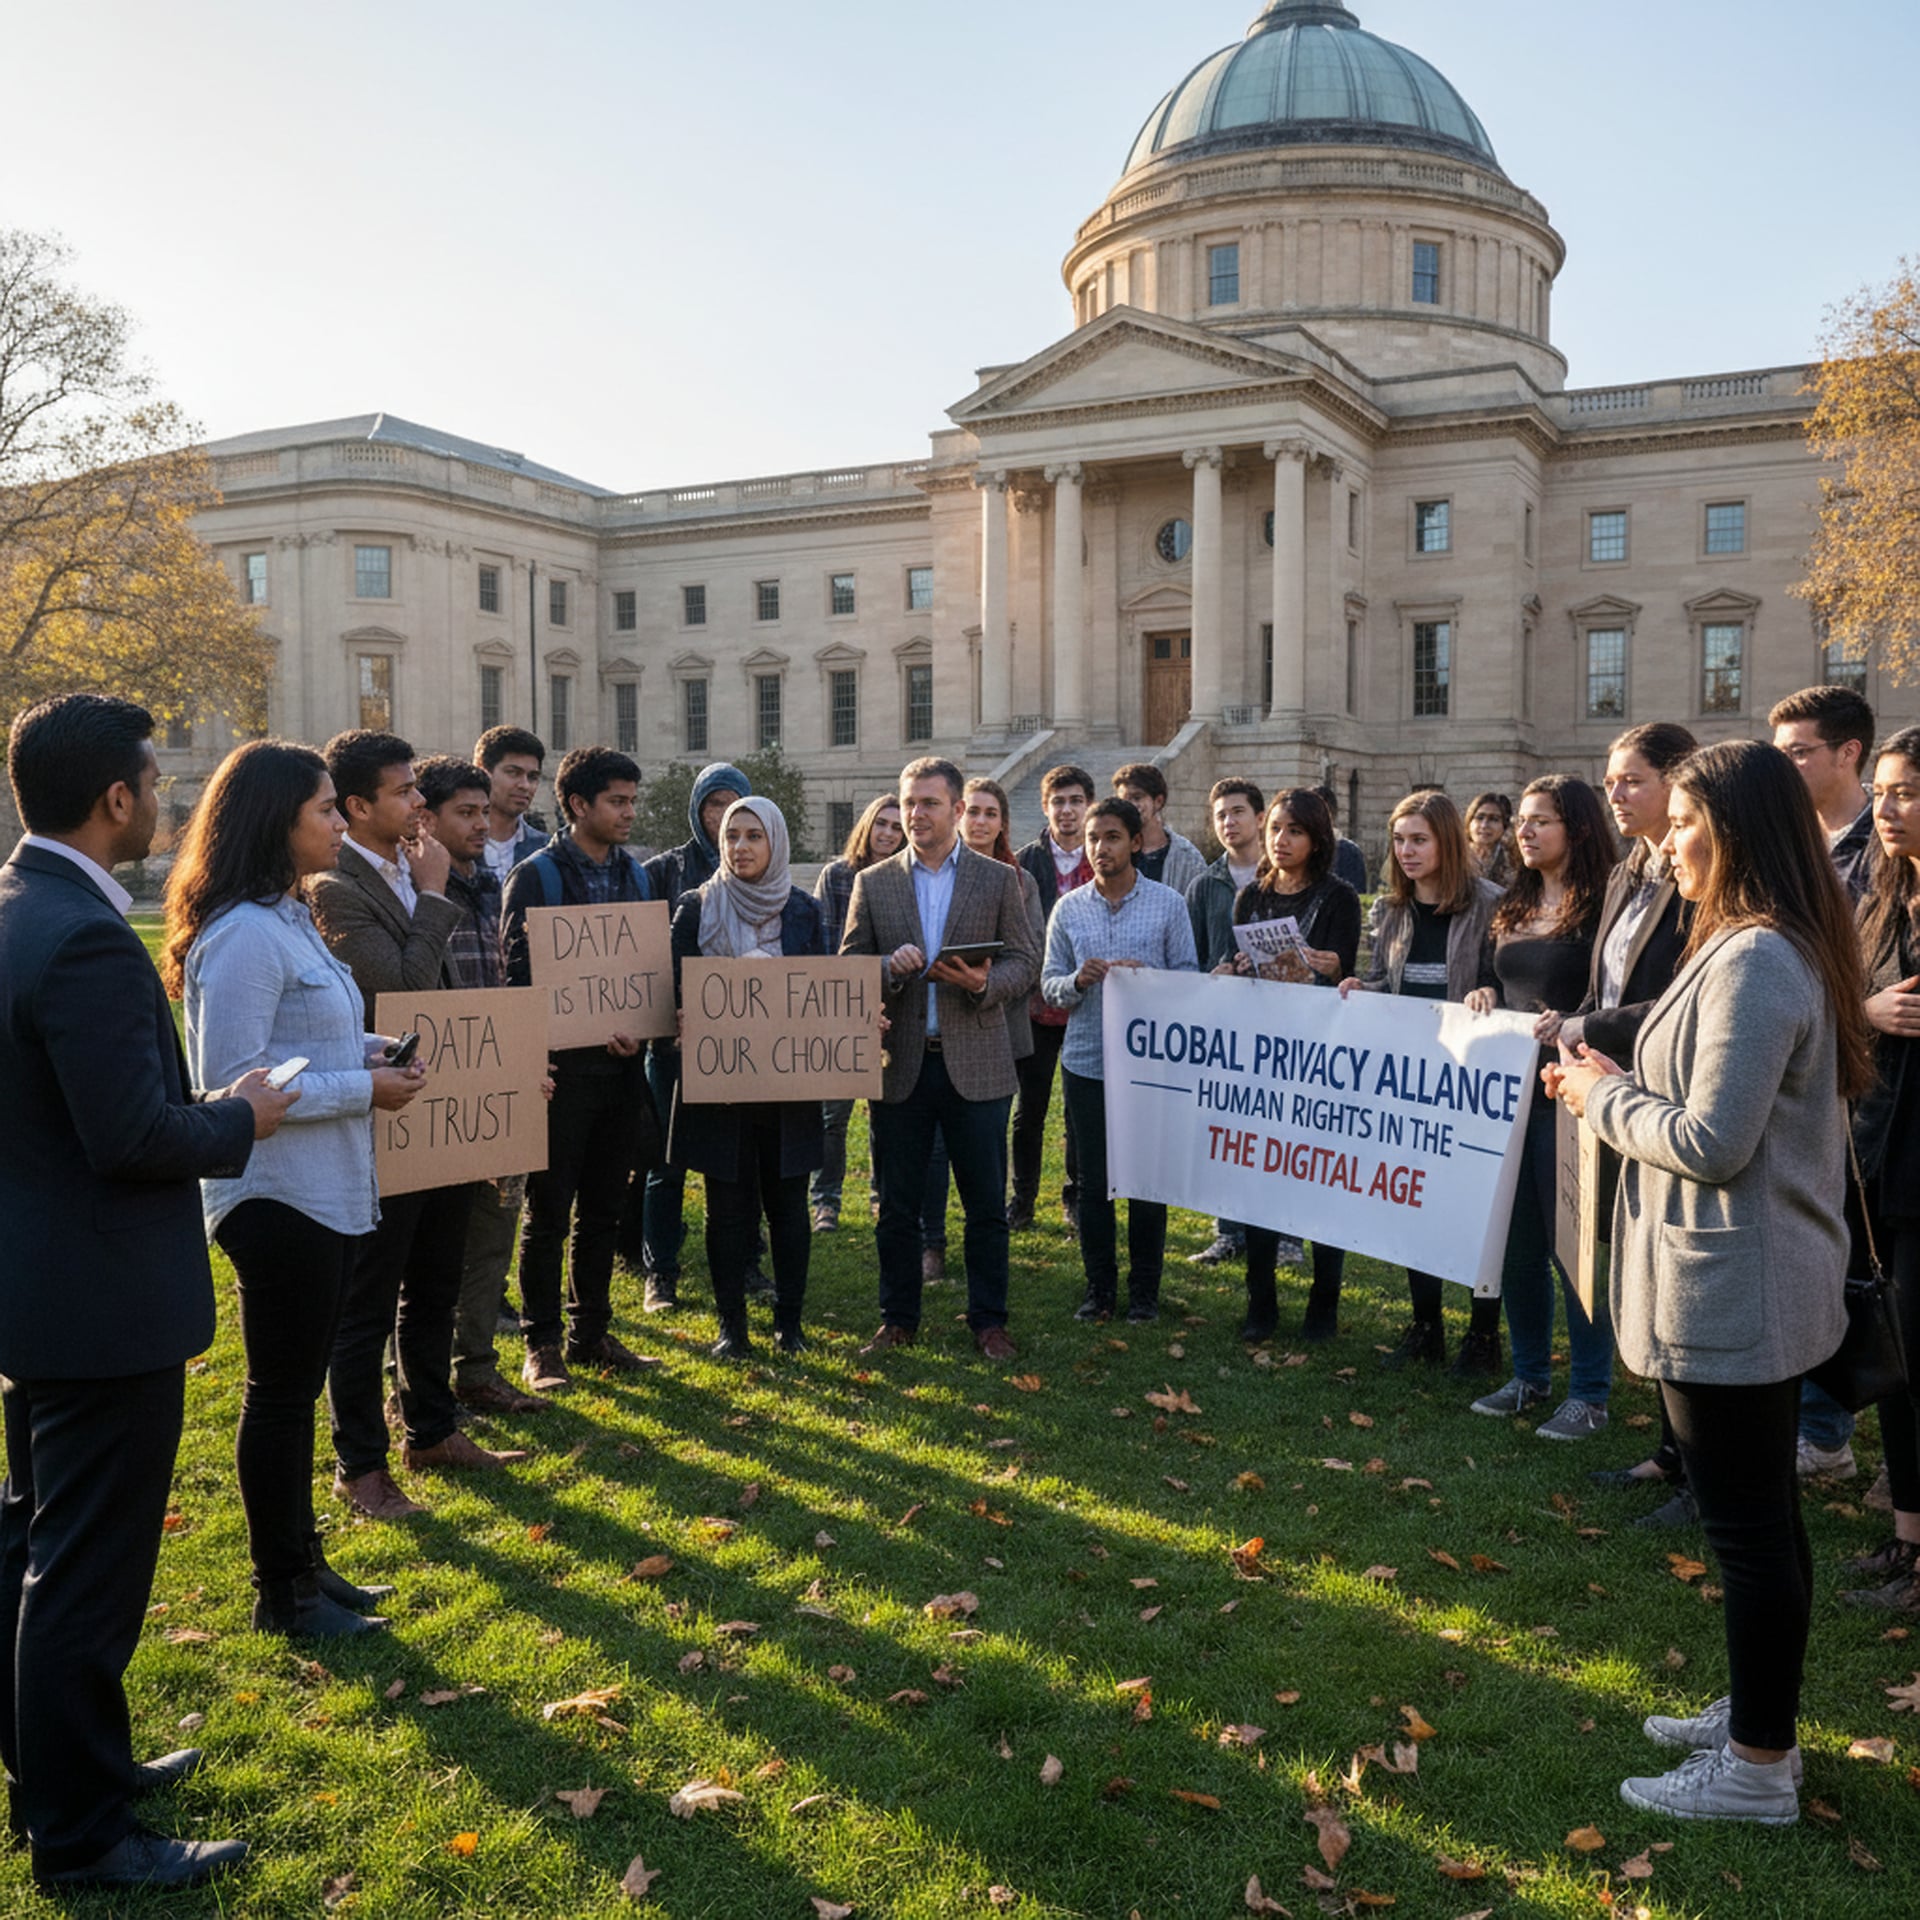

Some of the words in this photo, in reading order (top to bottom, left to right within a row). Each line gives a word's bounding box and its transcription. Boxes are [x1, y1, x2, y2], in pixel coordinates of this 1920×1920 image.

[553, 914, 638, 960] DATA
[553, 985, 574, 1016] IS
[579, 970, 659, 1014] TRUST
[701, 971, 770, 1020] OUR
[786, 971, 873, 1024] FAITH,
[696, 1035, 758, 1077] OUR
[771, 1034, 870, 1075] CHOICE
[1126, 1018, 1244, 1072] GLOBAL
[1253, 1033, 1370, 1092] PRIVACY
[1375, 1053, 1521, 1122] ALLANCE
[387, 1115, 410, 1151] IS
[422, 1090, 519, 1148] TRUST
[1197, 1078, 1284, 1122] HUMAN
[1290, 1093, 1373, 1140] RIGHTS
[1378, 1111, 1403, 1146] IN
[1409, 1116, 1454, 1158] THE
[1208, 1126, 1257, 1168] THE
[1263, 1137, 1362, 1193] DIGITAL
[1369, 1162, 1426, 1208] AGE
